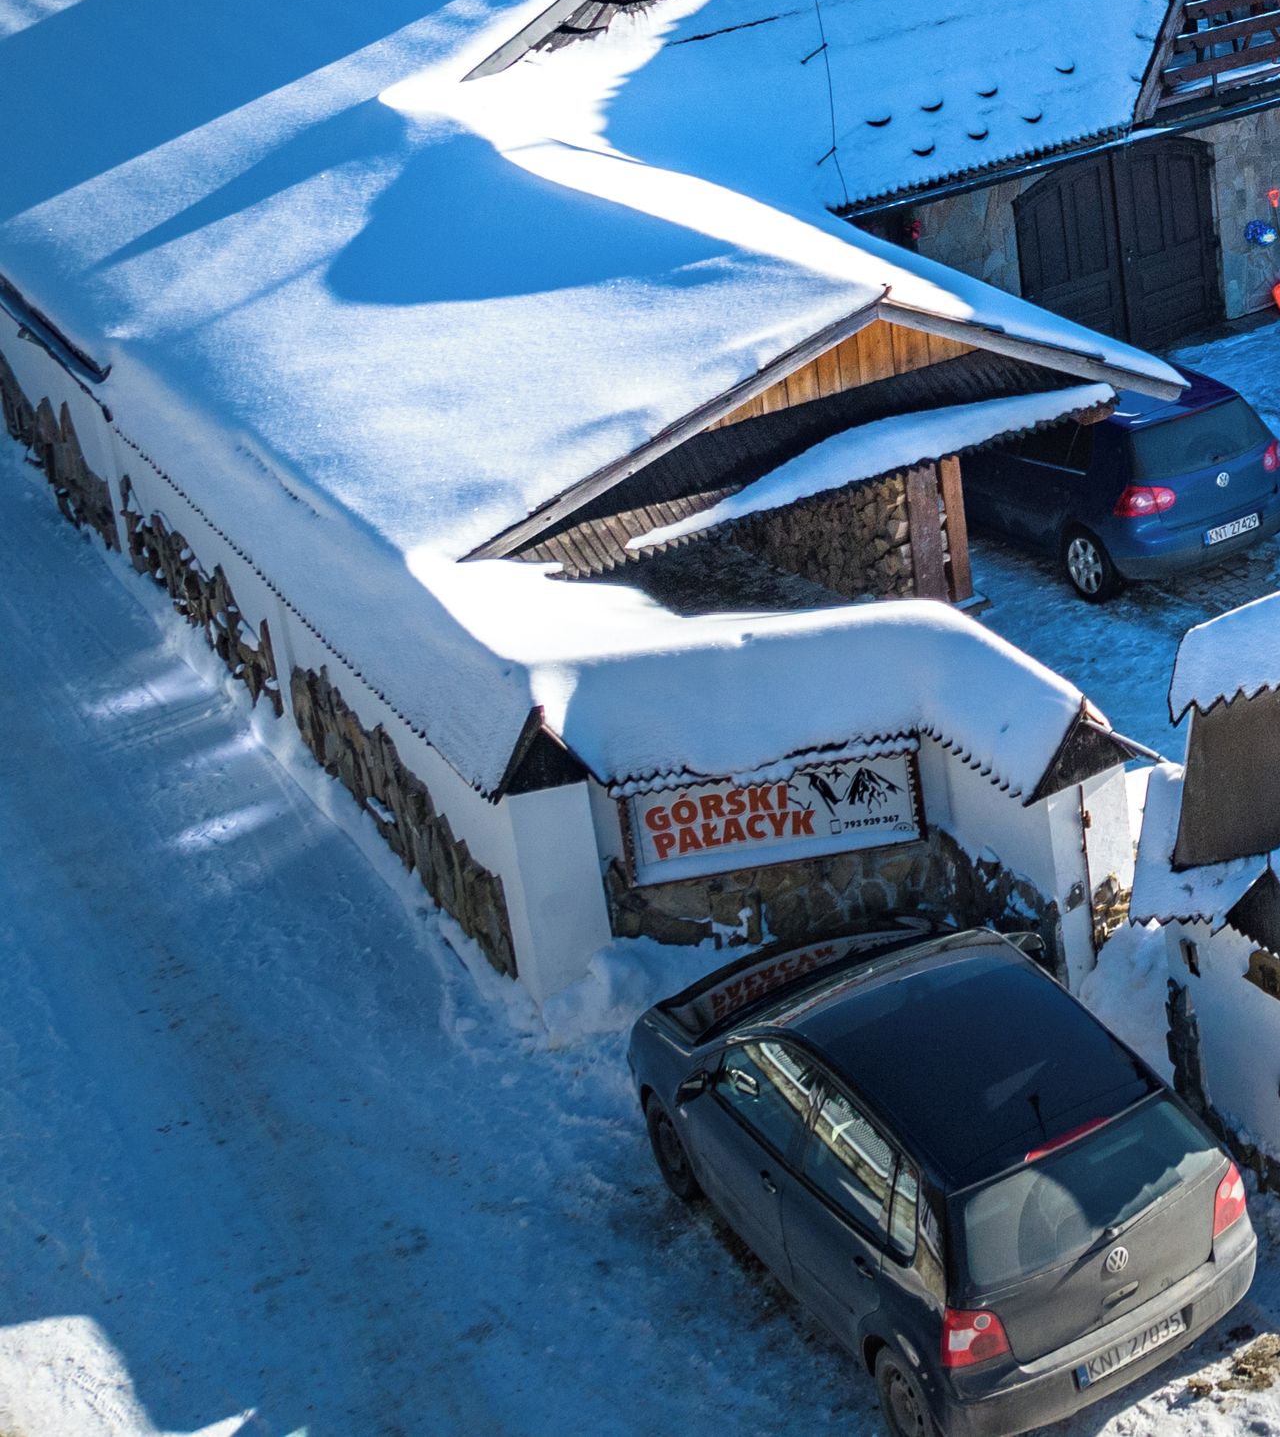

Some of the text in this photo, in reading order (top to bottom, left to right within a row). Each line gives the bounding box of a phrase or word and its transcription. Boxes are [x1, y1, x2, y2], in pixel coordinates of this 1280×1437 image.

[1209, 515, 1257, 542] KNT 27429
[645, 784, 788, 831] GÓRSKI
[844, 814, 899, 829] 793 939 367
[652, 809, 816, 860] PAŁACYK
